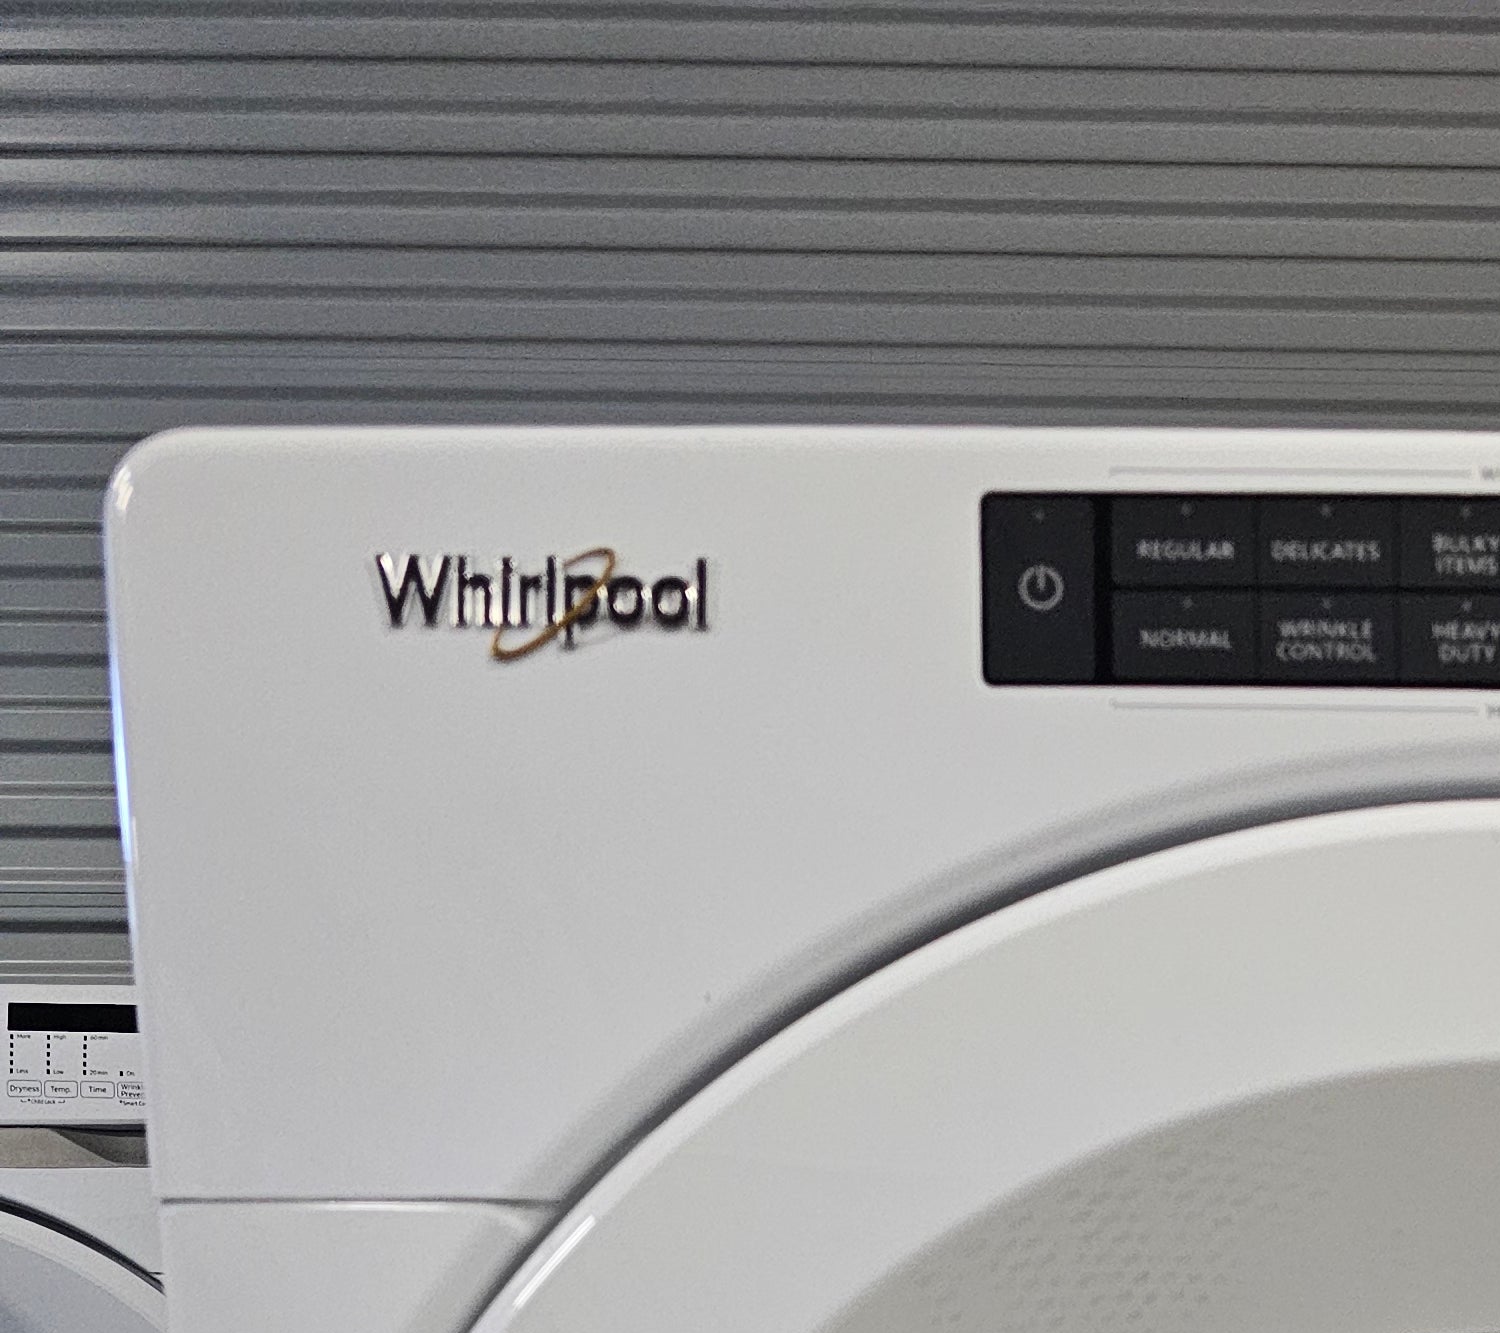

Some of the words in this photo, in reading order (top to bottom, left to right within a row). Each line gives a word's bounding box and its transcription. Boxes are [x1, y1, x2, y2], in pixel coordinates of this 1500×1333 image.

[1136, 539, 1235, 560] REGULAR
[1270, 540, 1381, 562] DELICATES
[1431, 533, 1500, 553] BULKY
[1434, 555, 1499, 576] ITEMS
[374, 550, 708, 656] Whirlpool
[1140, 629, 1233, 649] NORMAL
[1278, 619, 1373, 639] WRINKLE
[1275, 641, 1377, 663] CONTROL
[1437, 643, 1497, 663] DUTY
[10, 1084, 40, 1094] Dryness
[88, 1084, 107, 1094] Time
